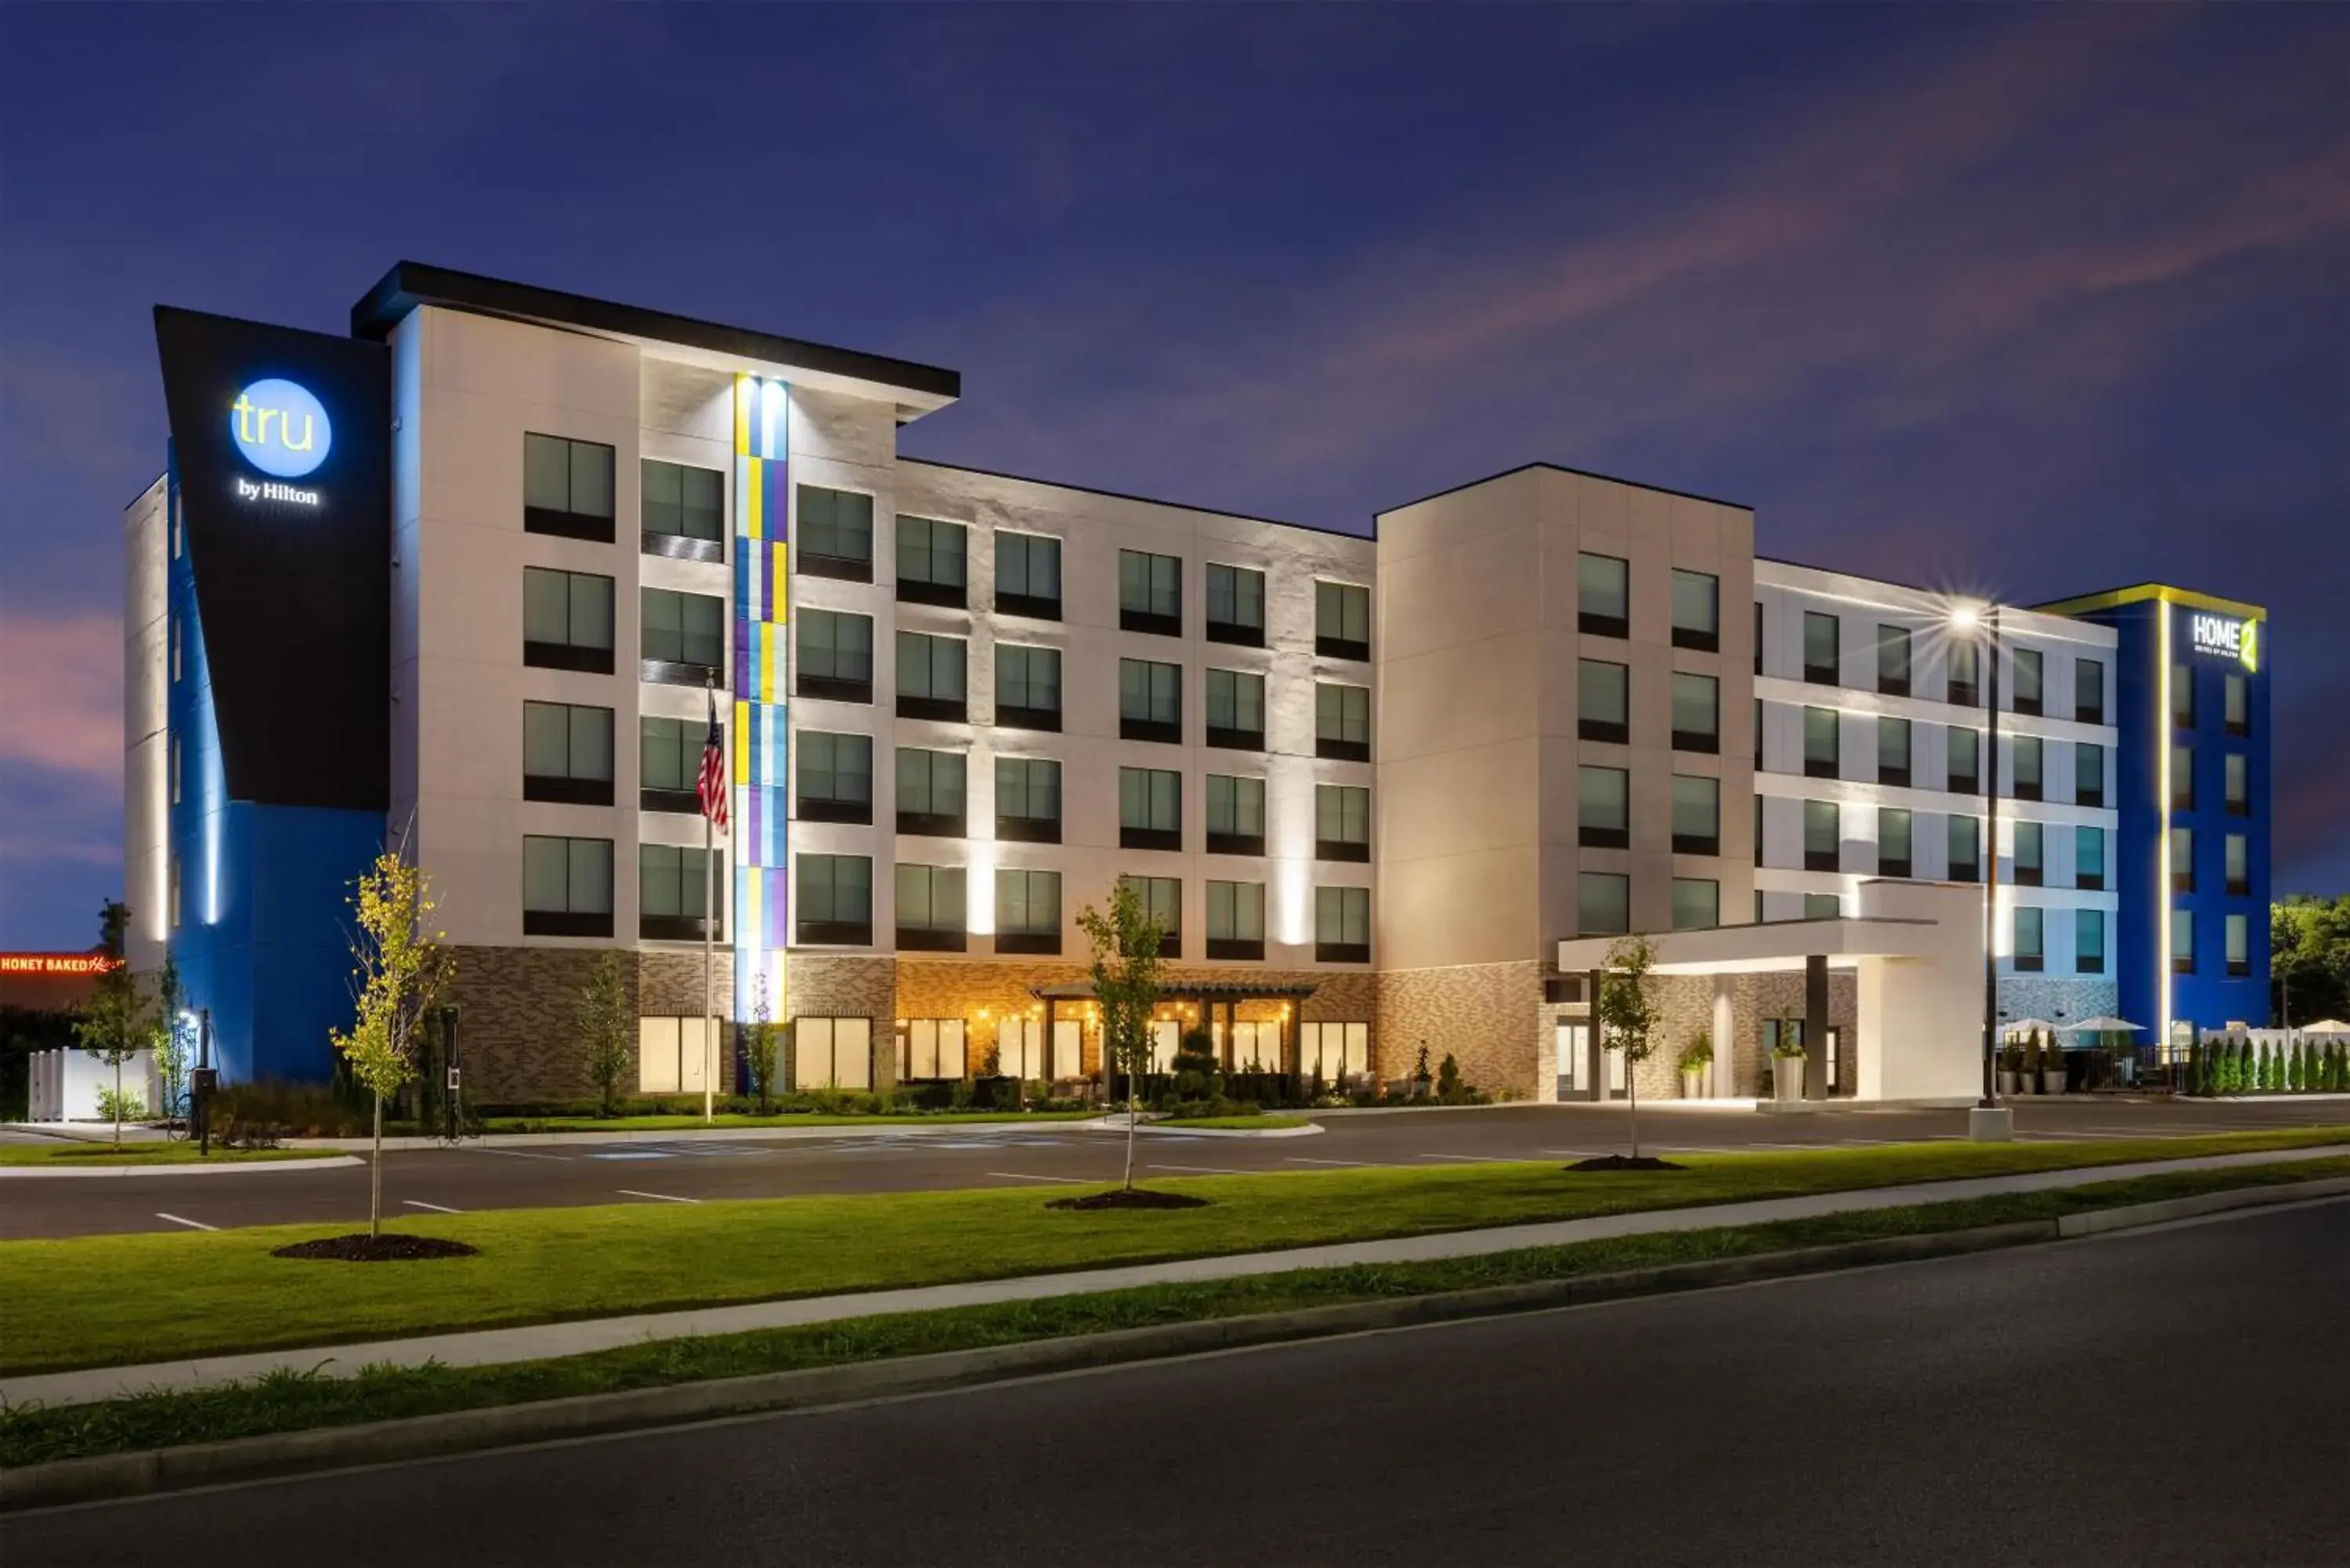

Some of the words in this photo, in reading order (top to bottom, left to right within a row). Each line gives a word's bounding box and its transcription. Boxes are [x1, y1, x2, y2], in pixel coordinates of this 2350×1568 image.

[233, 394, 313, 450] tru
[239, 479, 260, 500] by
[263, 482, 317, 504] Hilton
[2, 958, 44, 970] HONEY
[46, 959, 88, 971] BAKED
